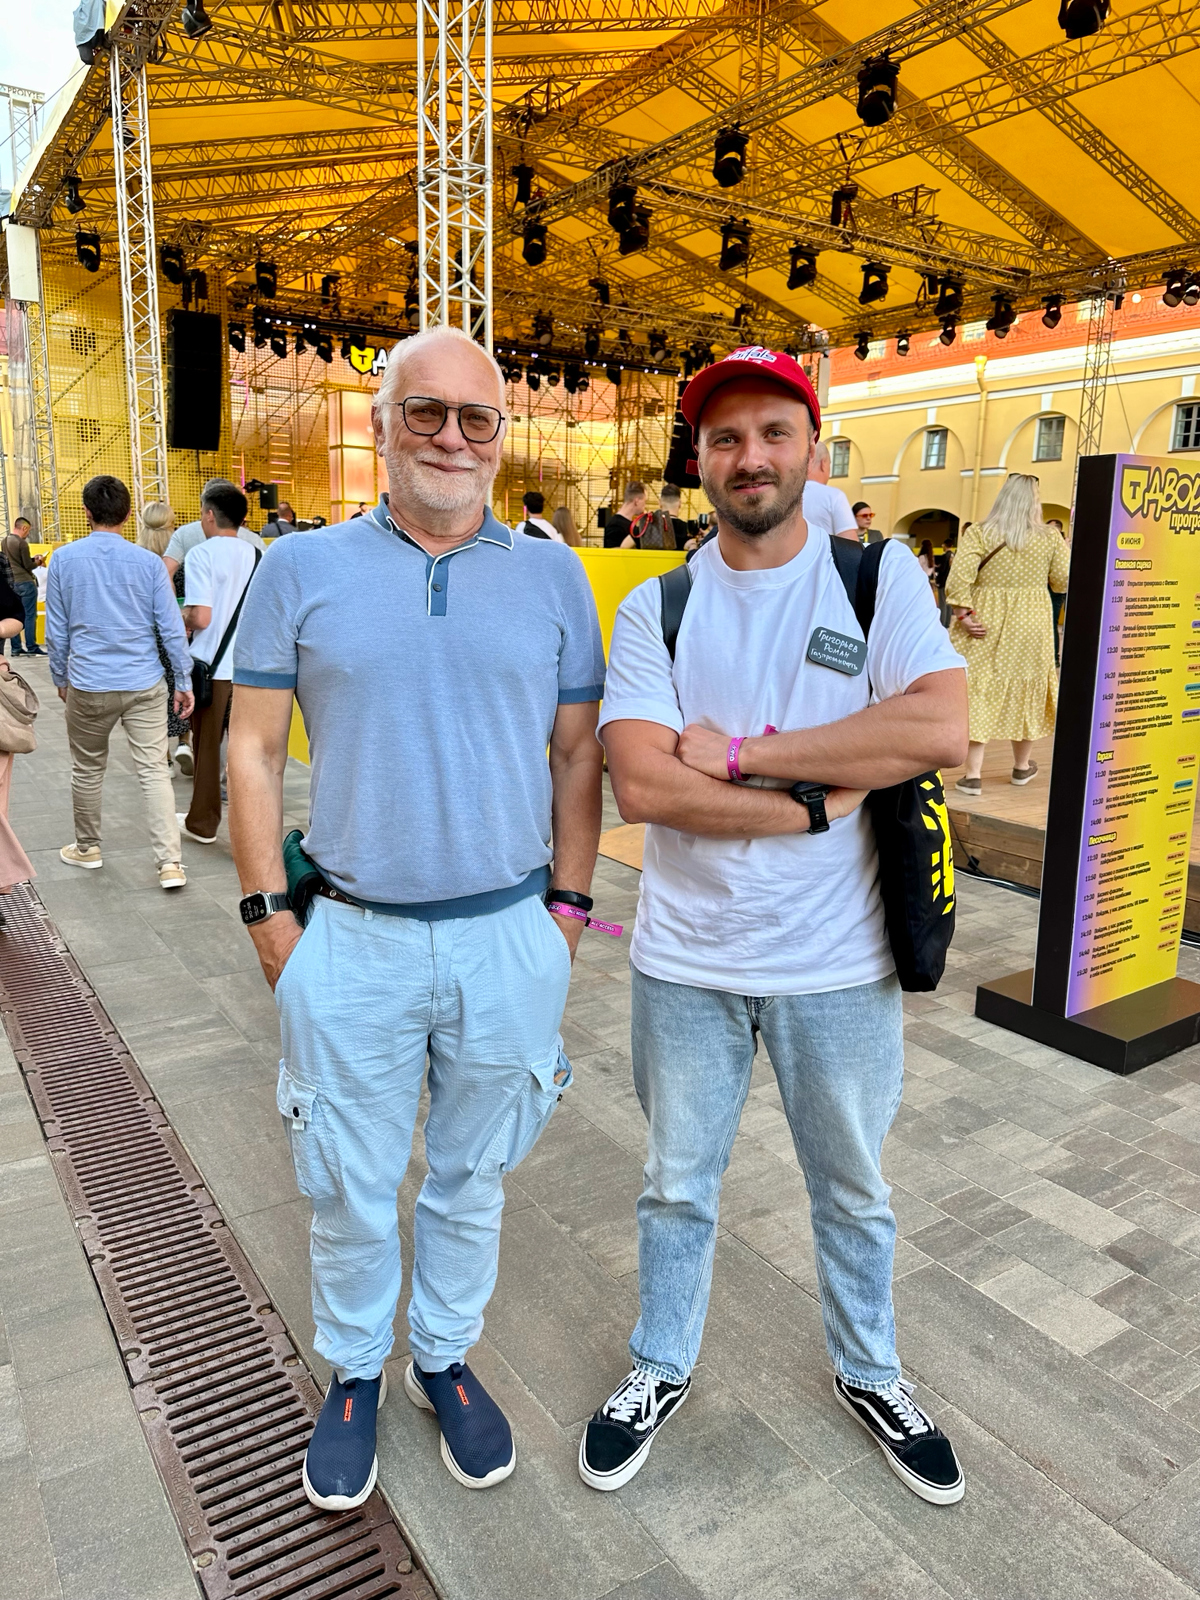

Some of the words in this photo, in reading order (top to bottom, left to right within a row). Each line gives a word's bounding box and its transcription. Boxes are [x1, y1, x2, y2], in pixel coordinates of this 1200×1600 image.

[1120, 537, 1125, 545] 6
[1125, 537, 1141, 545] ИЮНЯ
[1115, 559, 1136, 569] Главная
[1136, 560, 1152, 571] сцена
[818, 630, 858, 653] Григорьев
[824, 643, 850, 658] Роман
[1088, 832, 1117, 846] Песочница
